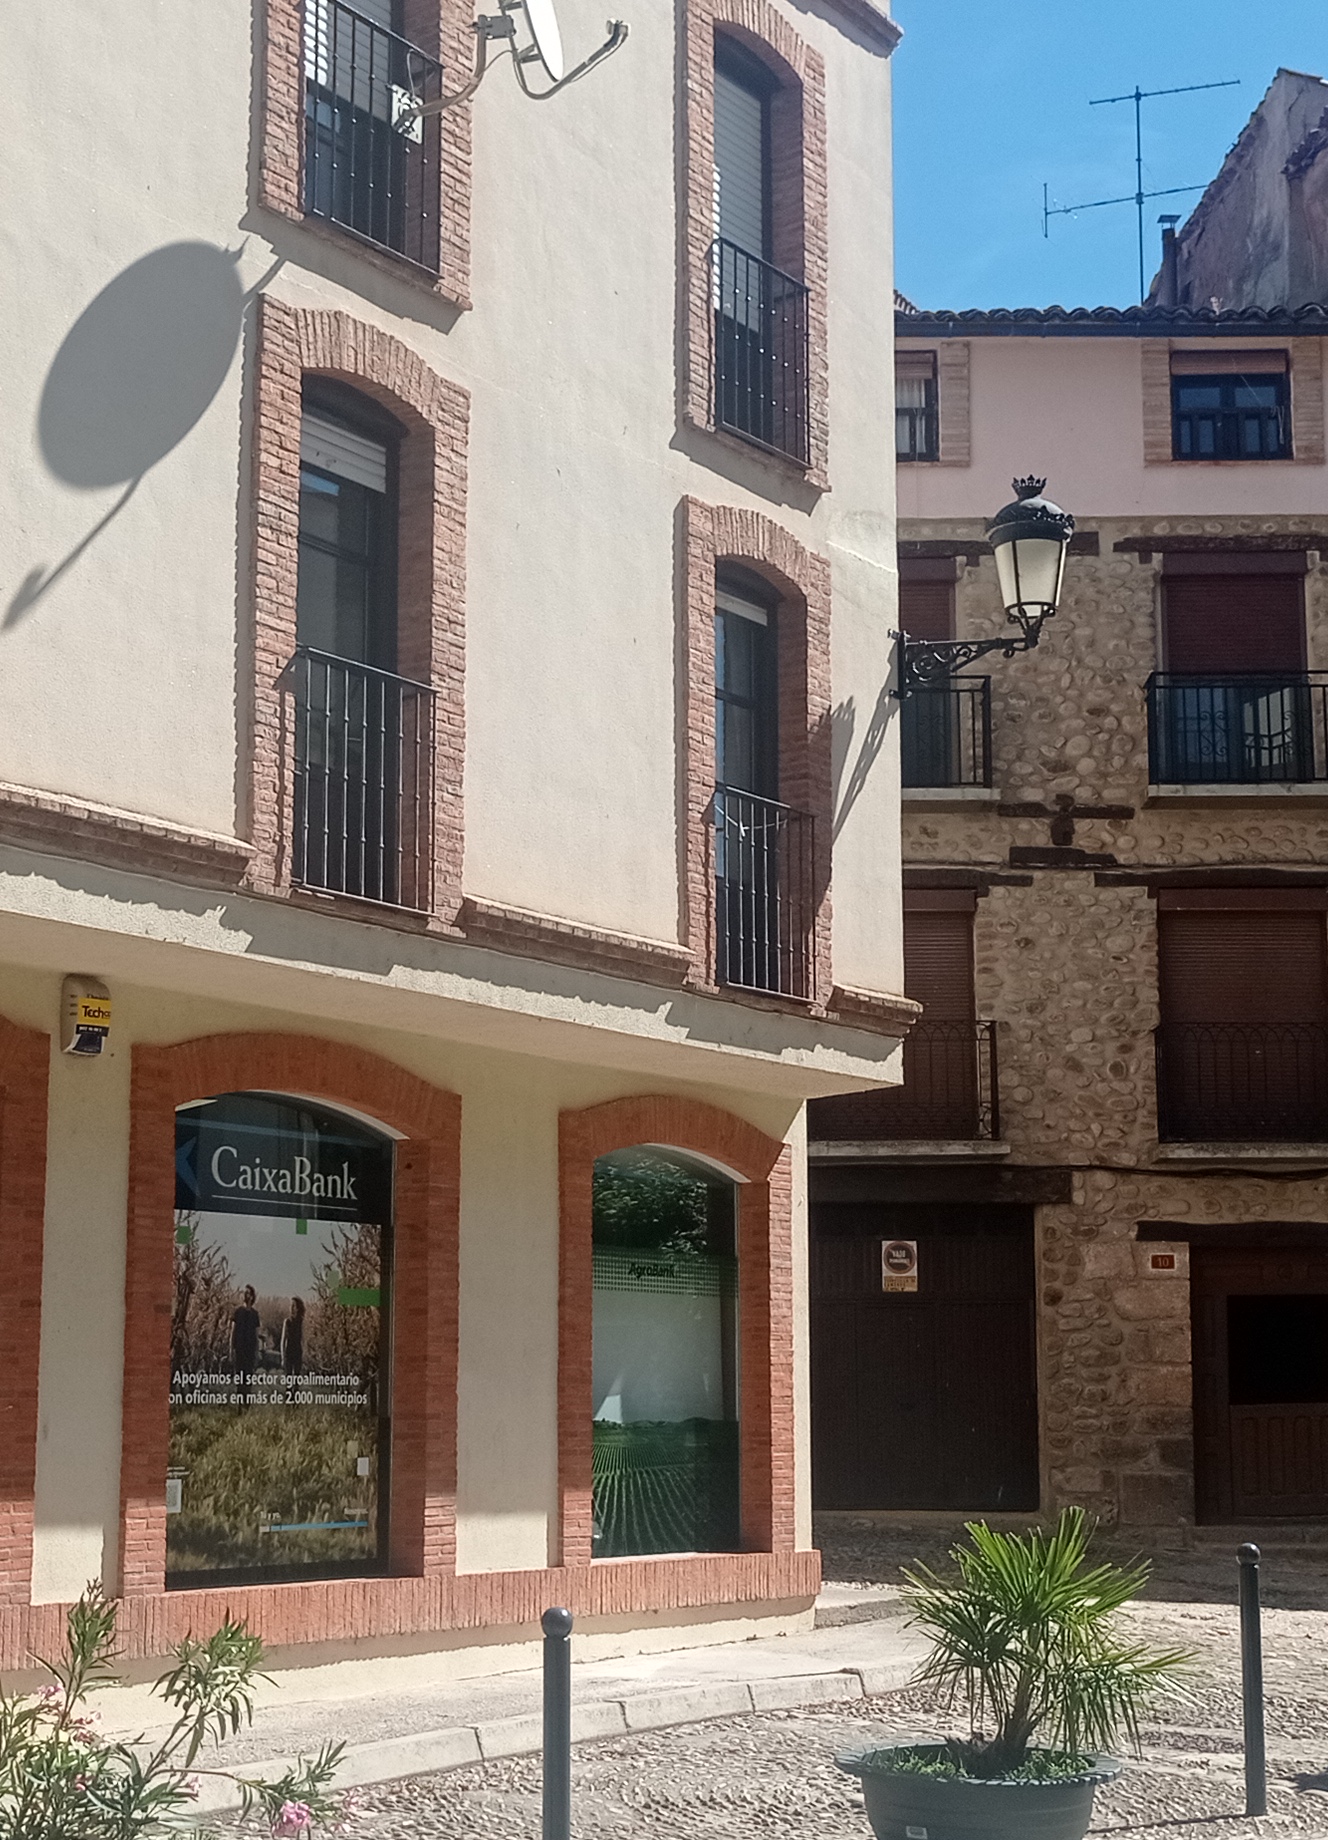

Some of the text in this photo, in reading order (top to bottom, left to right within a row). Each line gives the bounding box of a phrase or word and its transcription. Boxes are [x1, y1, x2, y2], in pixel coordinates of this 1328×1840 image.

[211, 1145, 358, 1200] CaixaBank
[1158, 1256, 1169, 1267] 10
[628, 1262, 675, 1279] AgroBank
[172, 1370, 359, 1389] Apoyamos el sector agroalimentario
[169, 1390, 367, 1407] on oficinas en más de 2.000 municipios
